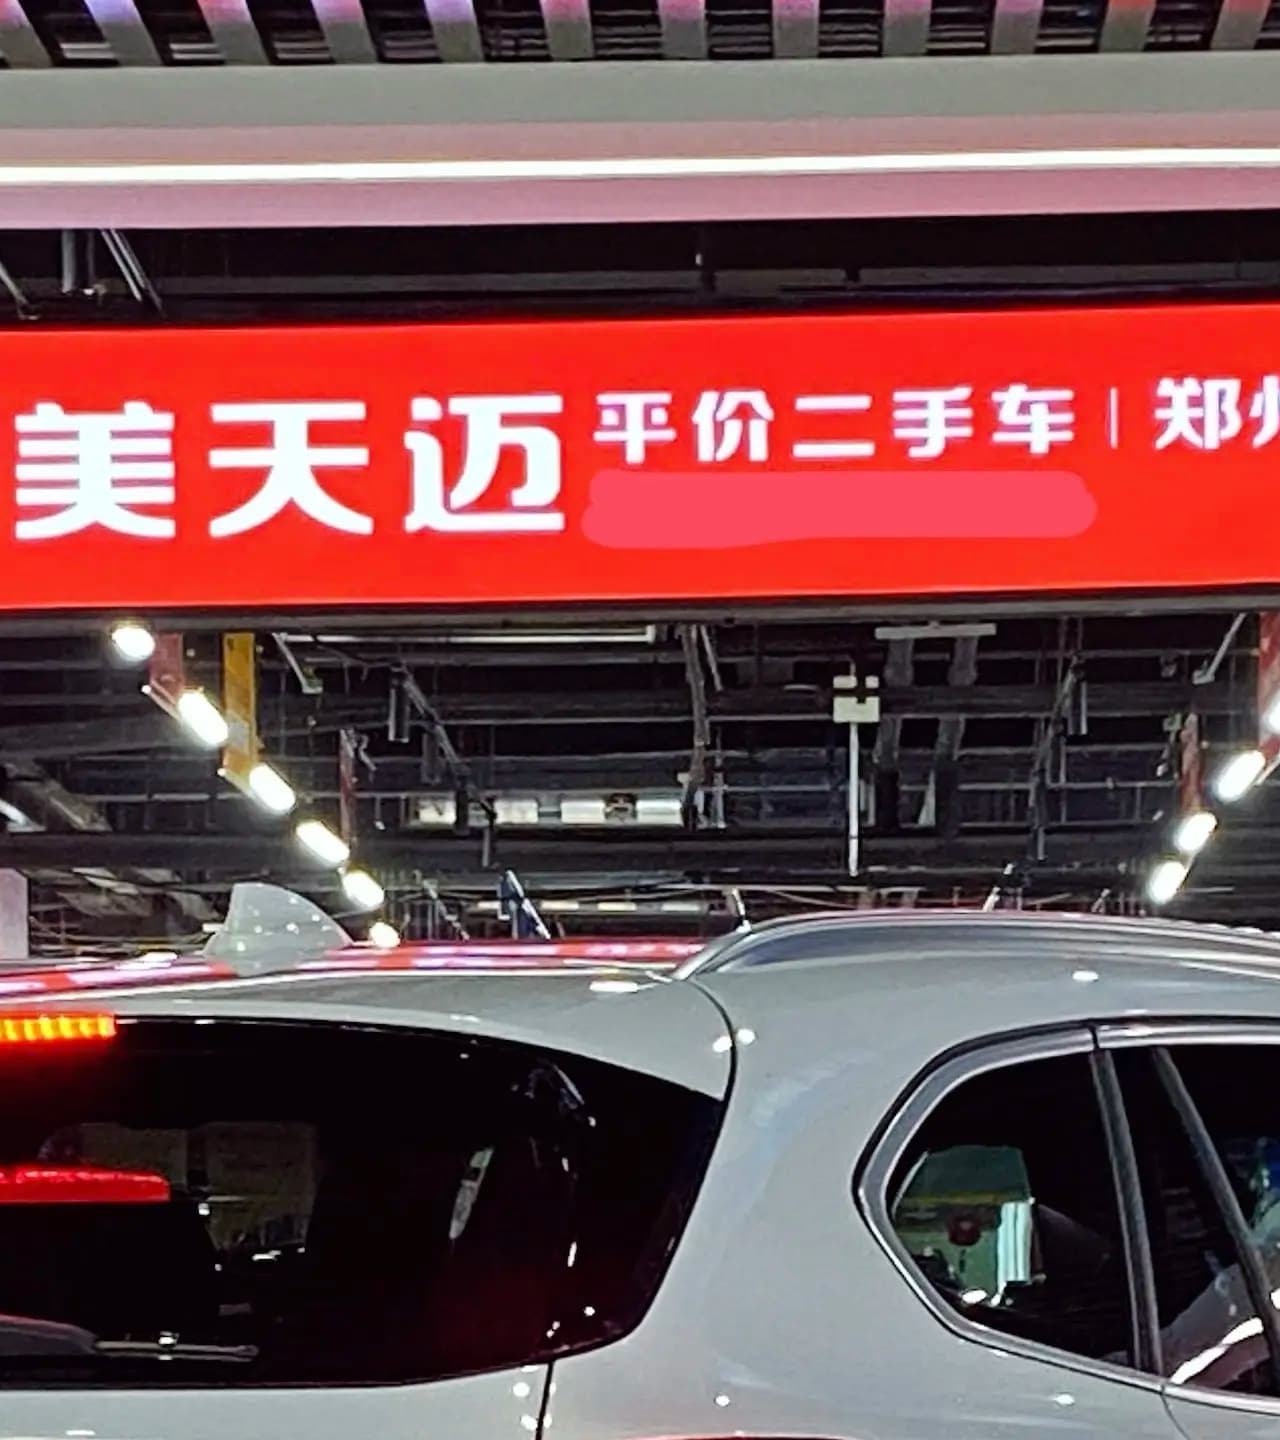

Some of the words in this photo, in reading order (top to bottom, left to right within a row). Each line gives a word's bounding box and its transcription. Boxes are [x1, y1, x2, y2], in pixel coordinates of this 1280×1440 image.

[13, 394, 565, 541] 美天迈
[593, 384, 1077, 466] 平价二手车
